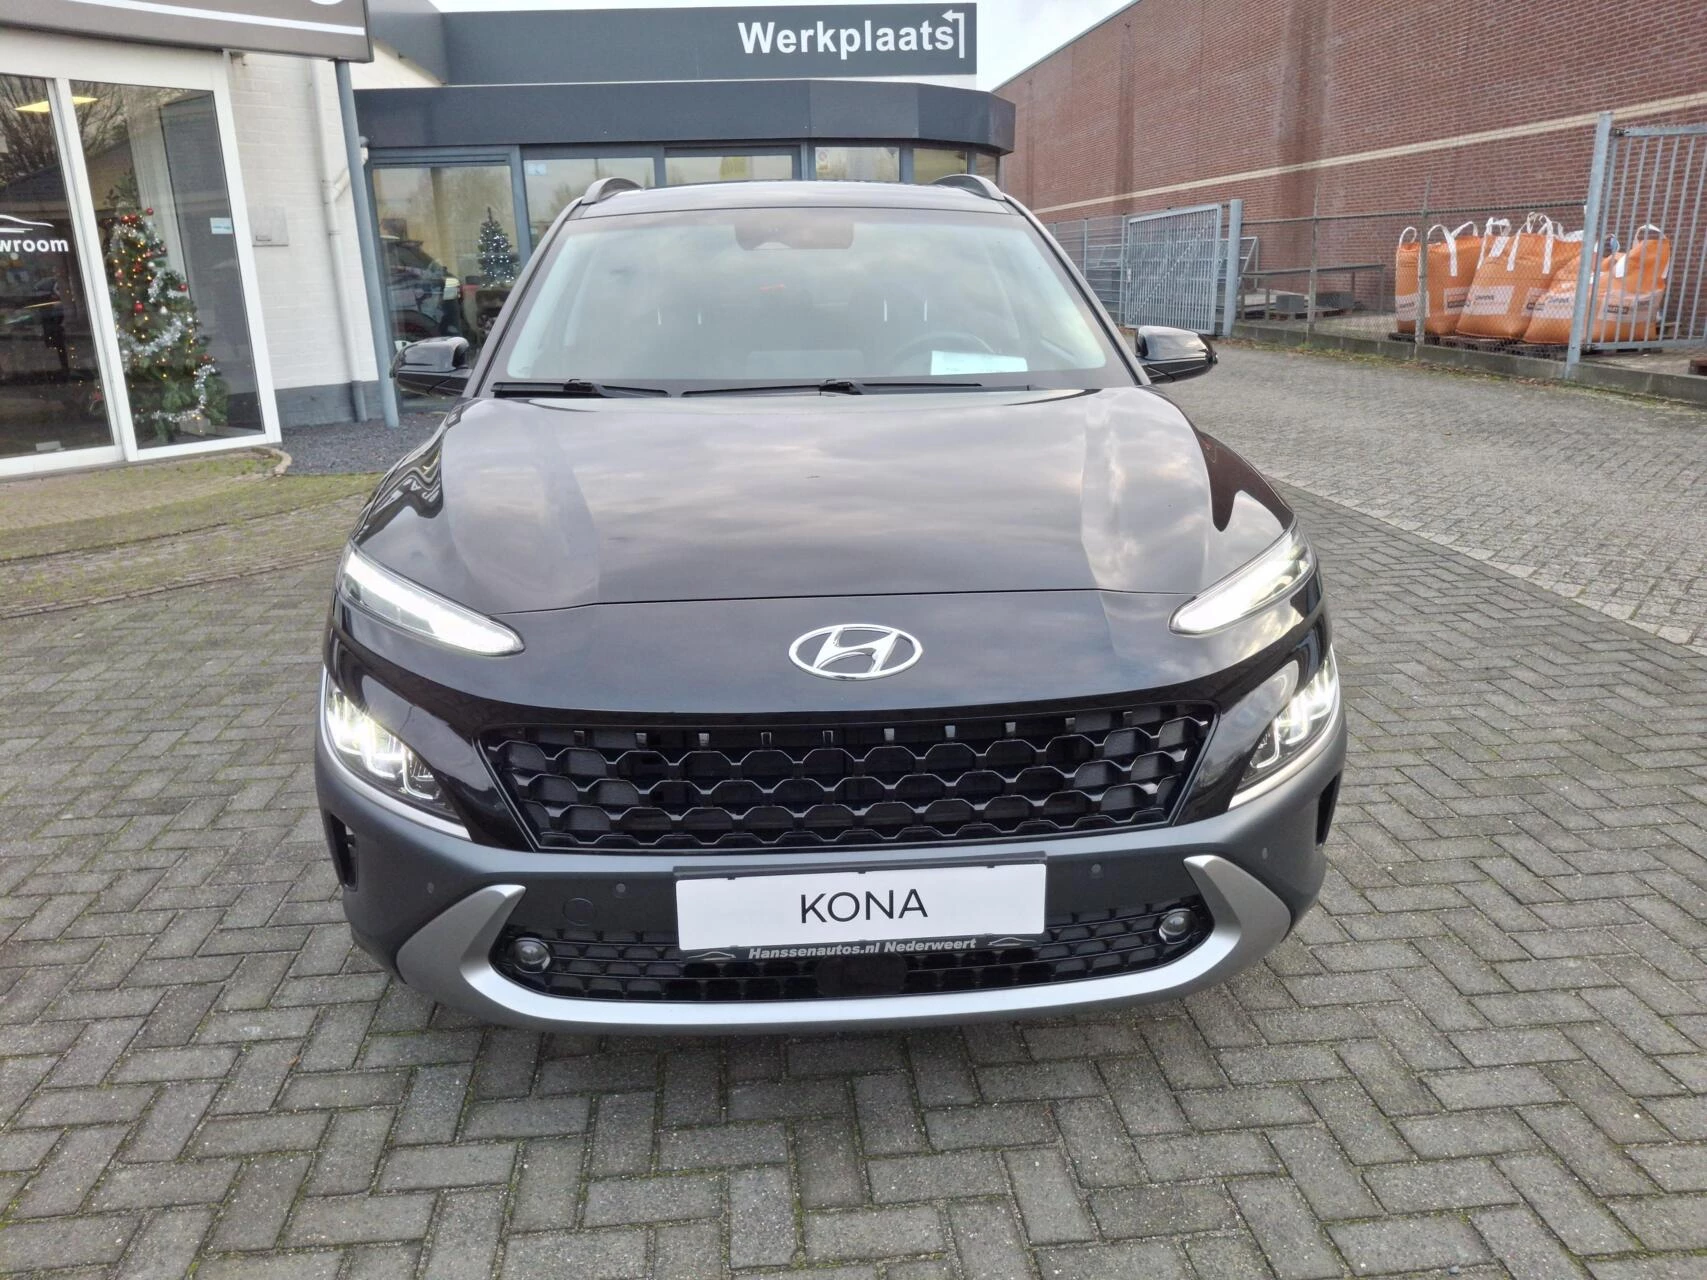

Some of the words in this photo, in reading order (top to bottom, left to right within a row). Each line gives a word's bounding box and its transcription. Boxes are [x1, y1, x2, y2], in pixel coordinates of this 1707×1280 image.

[737, 20, 954, 60] Werkplaats
[801, 888, 928, 924] KONA
[749, 942, 880, 959] Hanssenautos.nl
[884, 938, 977, 953] Nederweert
